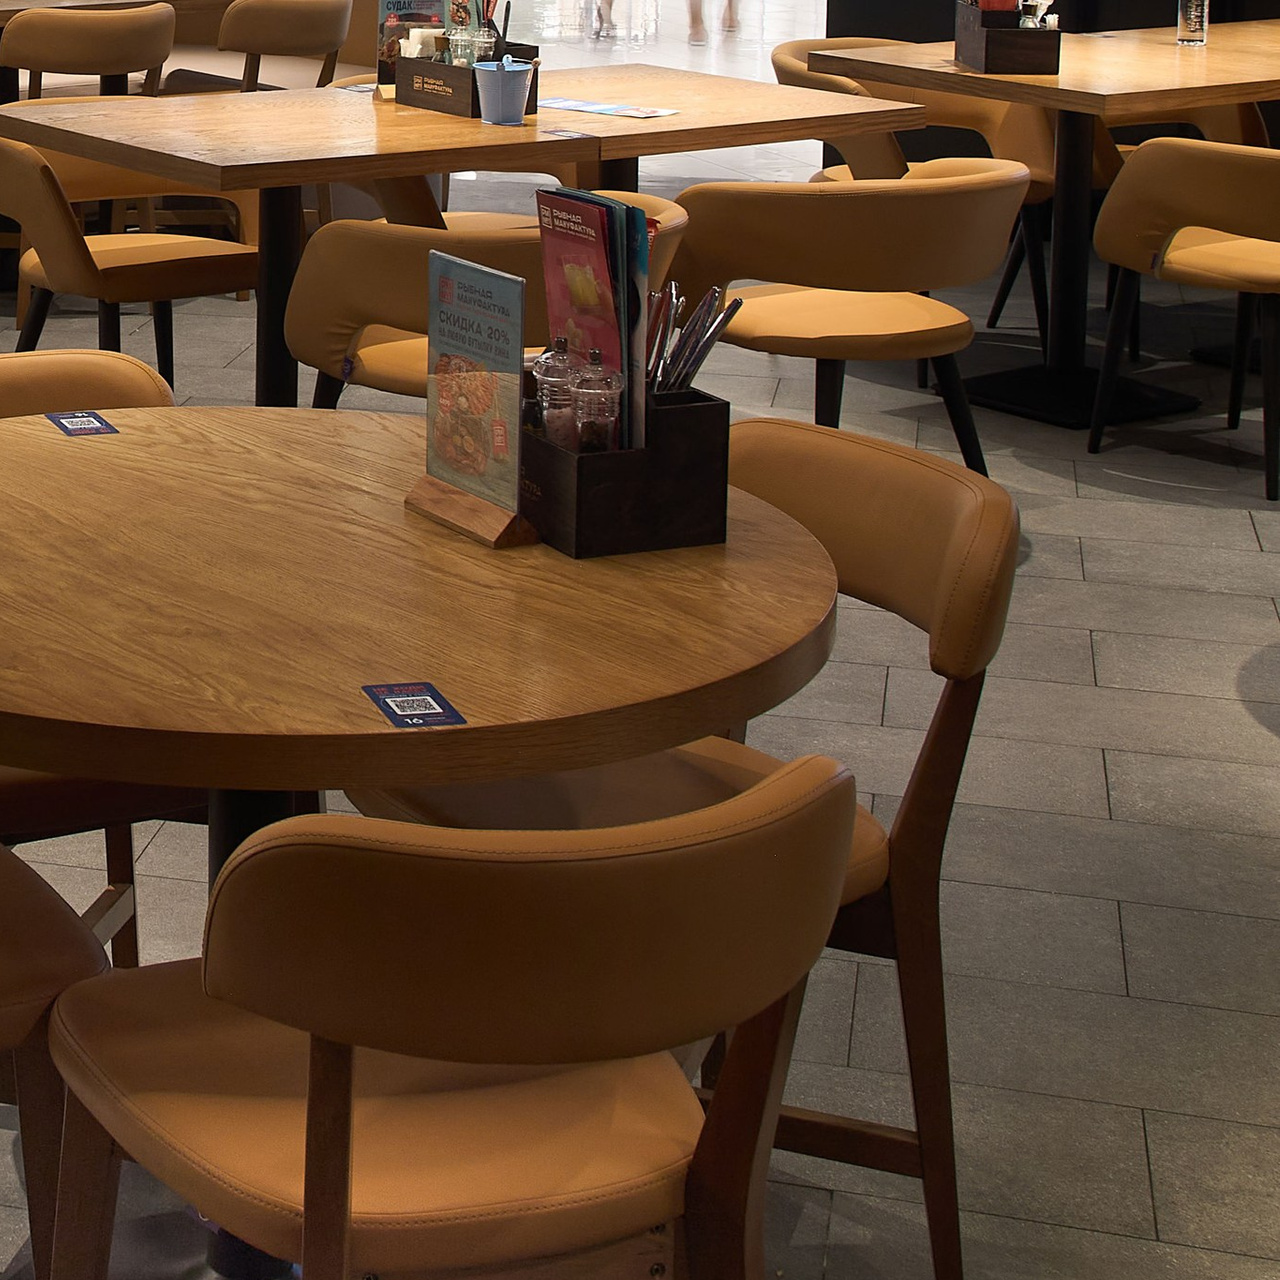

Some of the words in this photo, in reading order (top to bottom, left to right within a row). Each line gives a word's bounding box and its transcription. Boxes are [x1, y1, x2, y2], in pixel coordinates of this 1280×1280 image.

[386, 0, 413, 12] СУДАК
[552, 209, 582, 224] РЫБНАЯ
[553, 218, 597, 238] МАНУФАКТУРА
[457, 281, 493, 299] РЫБНАЯ
[457, 292, 511, 317] МАНУФАКТУРА
[439, 310, 483, 337] СКИДКА
[487, 326, 511, 345] 20%
[404, 717, 424, 725] 16
